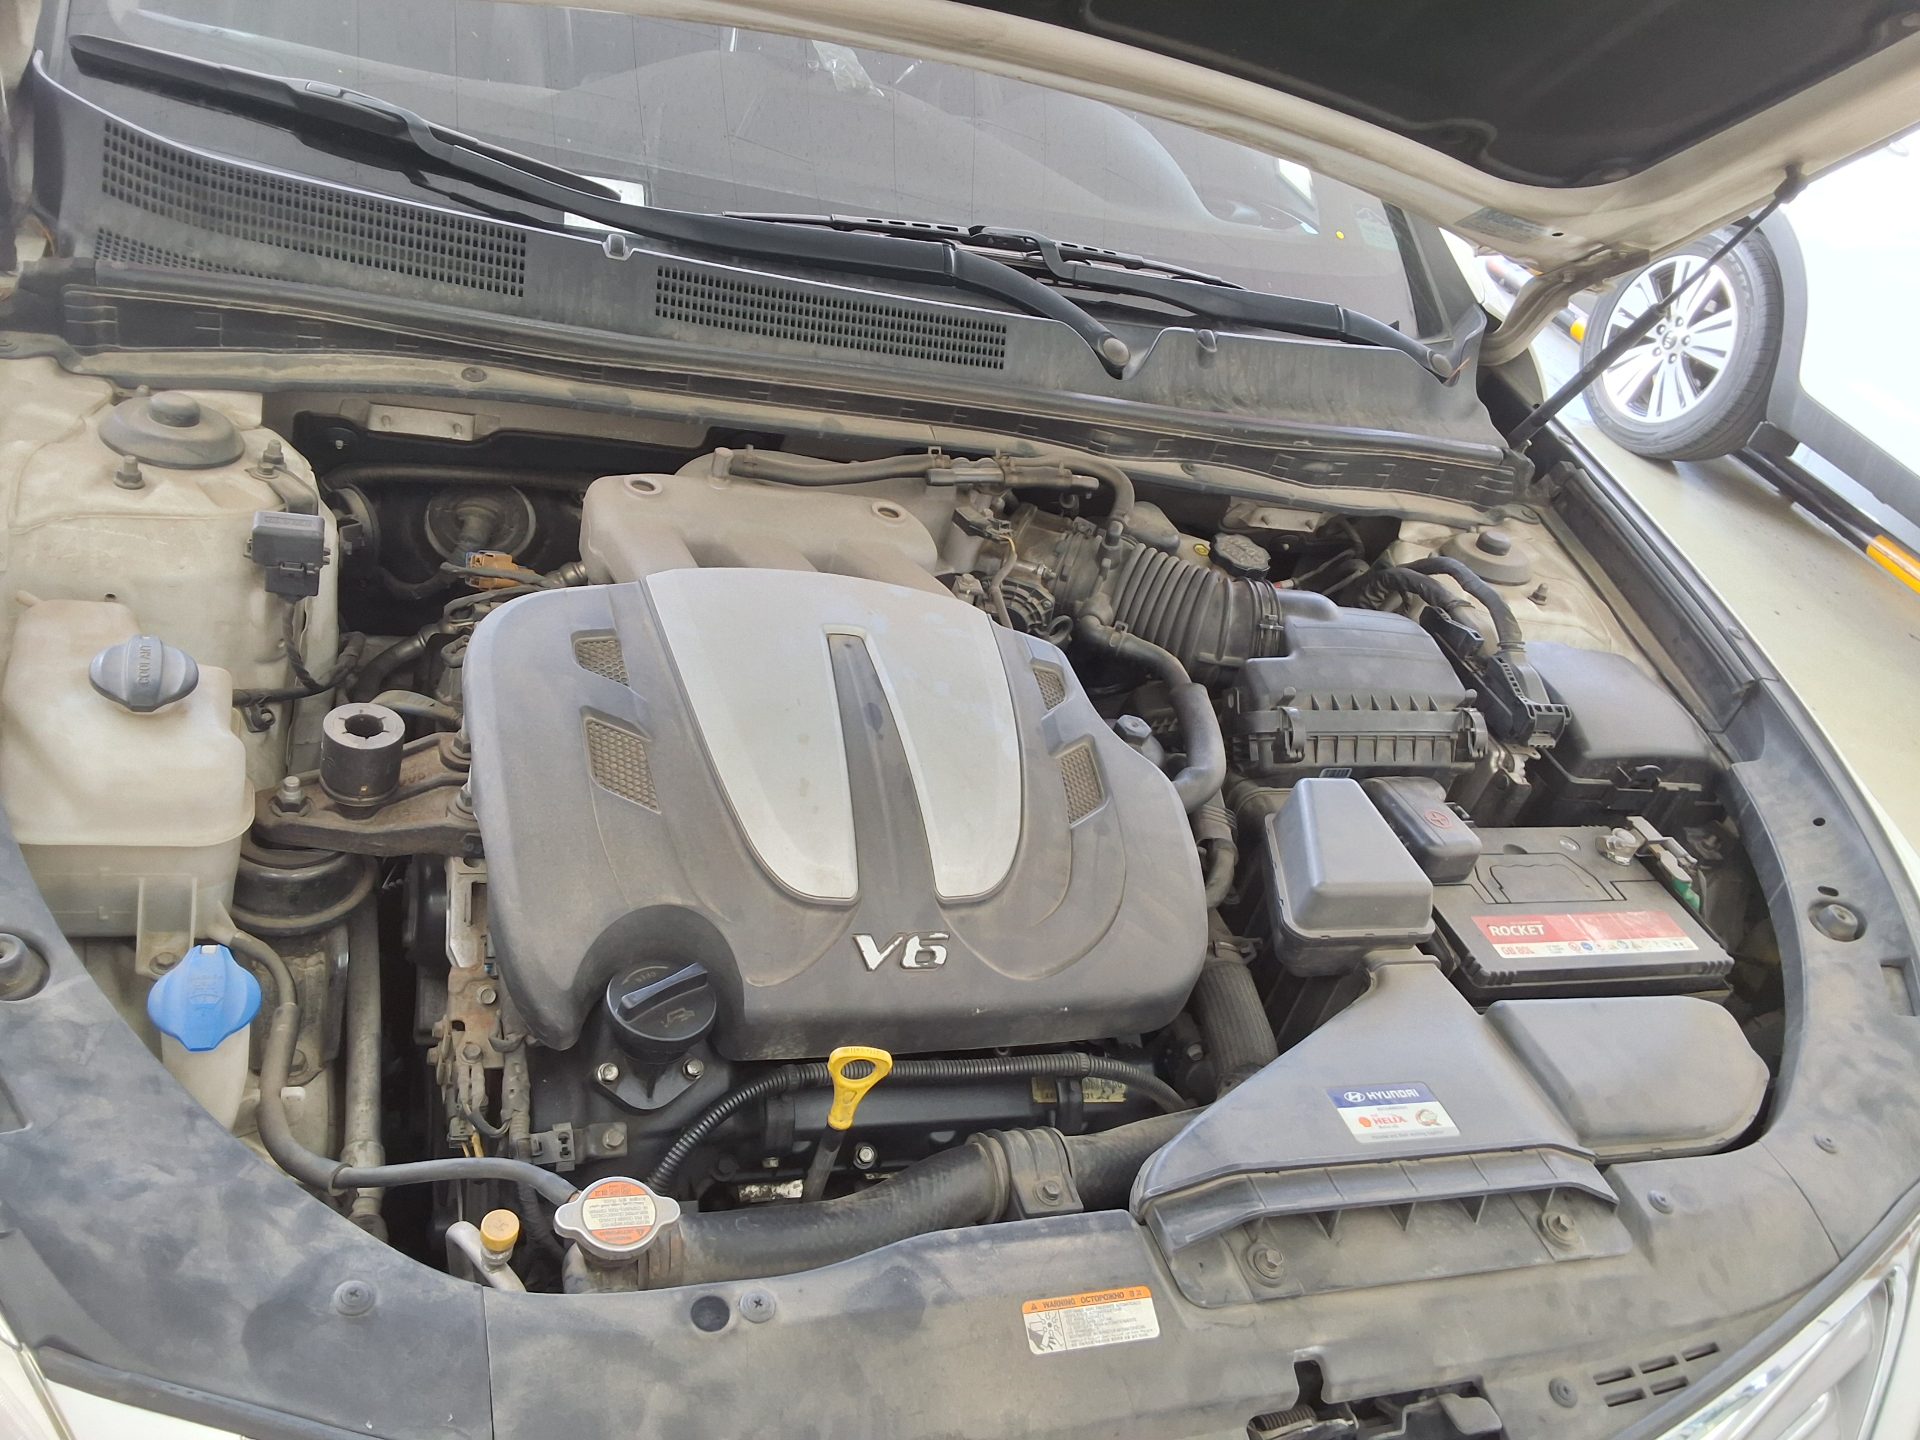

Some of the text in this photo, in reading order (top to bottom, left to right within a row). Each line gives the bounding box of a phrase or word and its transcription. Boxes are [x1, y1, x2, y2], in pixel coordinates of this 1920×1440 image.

[1490, 923, 1545, 936] ROCKET
[852, 931, 950, 971] V6
[1365, 1088, 1420, 1100] HYUNDAI
[1373, 1114, 1408, 1125] HELIX
[1042, 1296, 1076, 1310] WARNING
